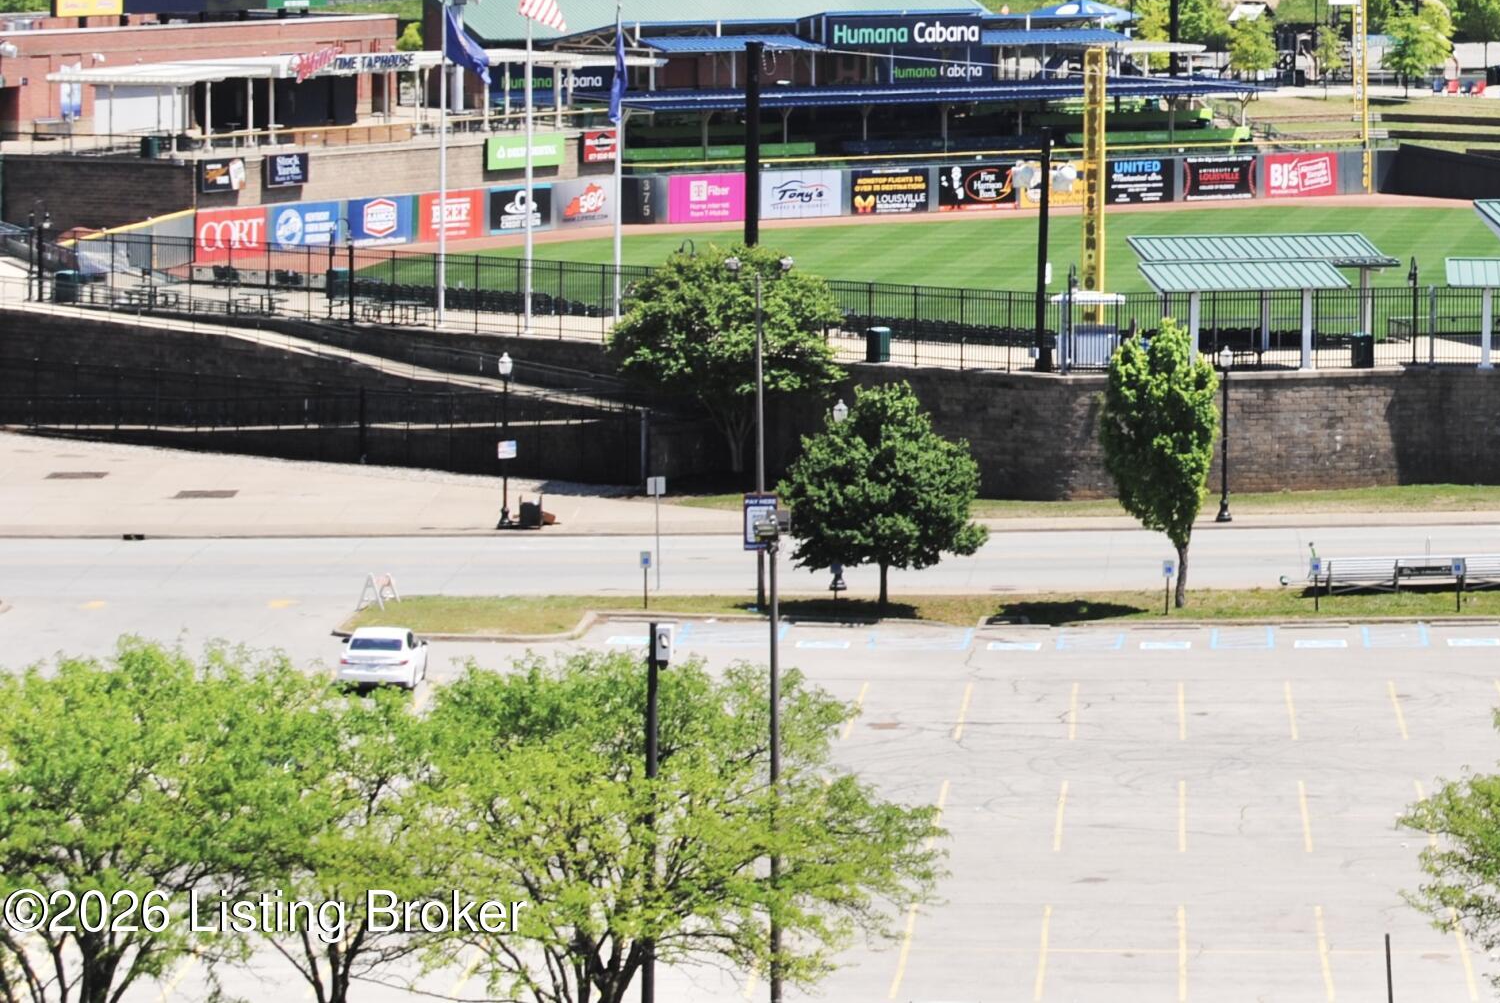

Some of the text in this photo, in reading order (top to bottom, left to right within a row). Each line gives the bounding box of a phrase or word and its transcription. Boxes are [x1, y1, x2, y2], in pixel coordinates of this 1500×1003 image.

[834, 21, 979, 44] Humana Cabana
[361, 53, 415, 68] TAPHOUSE
[276, 156, 300, 165] Stock
[1114, 161, 1161, 173] UNITED
[1199, 173, 1239, 181] LOUISVILLE
[1270, 158, 1298, 189] BJ's
[708, 185, 730, 196] Fiber
[779, 188, 824, 203] Tony's
[876, 193, 926, 203] LOUISVILLE
[431, 203, 471, 223] BEEF
[200, 217, 264, 252] CORT
